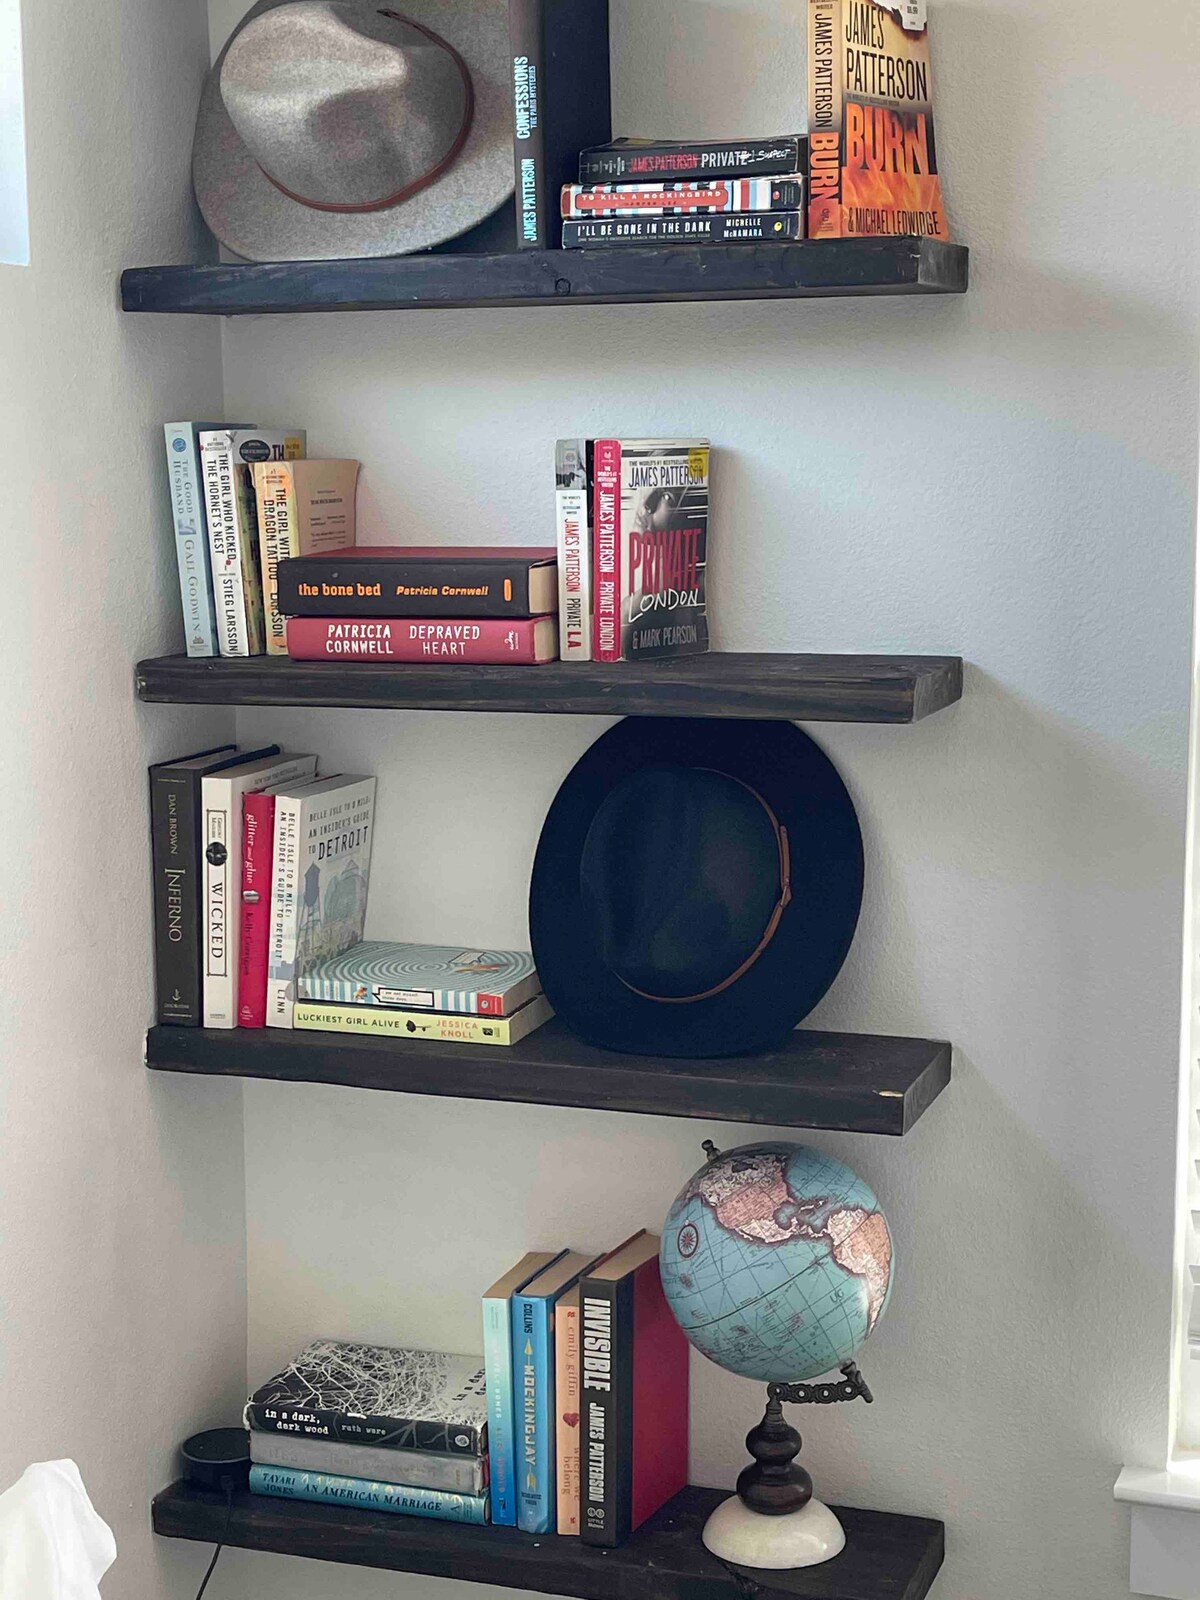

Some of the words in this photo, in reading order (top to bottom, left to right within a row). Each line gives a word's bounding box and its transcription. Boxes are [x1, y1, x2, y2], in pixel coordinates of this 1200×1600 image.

[815, 13, 832, 56] JAMES
[845, 0, 885, 50] JAMES
[846, 48, 928, 102] PATTERSON
[514, 56, 531, 140] CONFESSIONS
[815, 59, 832, 127] PATTERSON
[846, 102, 931, 173] BURN
[628, 156, 654, 173] JAMES
[655, 153, 697, 172] PATTERSON
[701, 151, 748, 168] PRIVATE
[810, 132, 839, 204] BURN
[521, 158, 536, 210] PATTERSON
[643, 191, 721, 199] MOCKINGBIRD
[524, 211, 538, 242] JAMES
[577, 225, 596, 236] I'LL
[600, 225, 612, 235] BE
[617, 224, 642, 235] GONE
[647, 223, 657, 234] IN
[662, 222, 680, 233] THE
[684, 221, 711, 233] DARK
[726, 218, 761, 227] MICHELLE
[848, 207, 854, 232] &
[855, 207, 891, 234] MICHAEL
[892, 210, 942, 235] LEDWIDGE
[207, 459, 218, 478] THE
[218, 453, 230, 472] THE
[629, 467, 658, 488] JAMES
[661, 465, 704, 486] PATTERSON
[220, 476, 231, 498] GIRL
[276, 488, 287, 507] THE
[208, 481, 222, 528] HORNET'S
[222, 499, 234, 522] WHO
[600, 491, 615, 523] JAMES
[264, 500, 277, 543] DRAGON
[277, 510, 289, 535] GIRL
[564, 518, 580, 546] JAMES
[213, 531, 225, 554] NEST
[225, 525, 237, 560] KICKED
[600, 524, 615, 574] PATTERSON
[565, 549, 581, 593] PATTERSON
[629, 531, 702, 596] PRIVATE
[223, 578, 235, 606] STIEG
[298, 583, 318, 596] the
[322, 583, 354, 596] bone
[357, 583, 381, 596] bed
[396, 585, 438, 596] Patricia
[441, 585, 489, 596] Cornwell
[600, 580, 615, 614] PRIVATE
[566, 598, 581, 629] PRIVATE
[628, 588, 703, 623] LONDON
[226, 609, 239, 652] LARSSON
[328, 624, 392, 639] PATRICIA
[409, 625, 480, 640] DEPRAVED
[600, 616, 615, 651] LONDON
[632, 634, 638, 649] &
[640, 629, 661, 649] MARK
[662, 625, 697, 647] PEARSON
[325, 640, 394, 654] CORNWELL
[422, 641, 466, 656] HEART
[168, 794, 176, 815] DAN
[280, 811, 287, 821] AN
[309, 809, 328, 823] BELLE
[330, 806, 342, 819] ISLE
[168, 817, 178, 855] BROWN
[246, 813, 258, 847] glitter
[287, 813, 295, 838] BELLE
[308, 827, 317, 839] AN
[320, 818, 351, 836] INSIDER'S
[353, 811, 370, 824] GUIDE
[278, 827, 287, 873] INSIDER'S
[287, 845, 295, 863] ISLE
[308, 845, 316, 854] TO
[318, 826, 369, 861] DETROIT
[245, 860, 257, 884] glue
[286, 869, 294, 879] TO
[277, 878, 285, 903] GUIDE
[164, 868, 186, 943] INFERNO
[276, 908, 283, 918] TO
[211, 882, 223, 959] WICKED
[275, 923, 283, 959] DETROIT
[277, 989, 285, 1014] LINN
[297, 1013, 343, 1024] LUCKIEST
[346, 1017, 368, 1026] GIRL
[371, 1019, 400, 1029] ALIVE
[436, 1020, 478, 1030] JESSICA
[441, 1029, 474, 1039] KNOLL
[524, 1304, 532, 1334] COLLINS
[566, 1326, 577, 1358] emily
[584, 1297, 610, 1392] INVISIBLE
[566, 1364, 577, 1396] giffin
[265, 1408, 277, 1418] in
[292, 1411, 321, 1424] dark,
[276, 1421, 300, 1432] dark
[305, 1424, 329, 1435] wood
[524, 1365, 535, 1466] MOCKINGJAY
[589, 1402, 605, 1440] JAMES
[341, 1424, 362, 1434] ruth
[366, 1426, 386, 1436] ware
[262, 1473, 296, 1485] TAYARI
[561, 1456, 573, 1495] belong
[589, 1442, 605, 1503] PATTERSON
[263, 1483, 294, 1496] JONES
[304, 1483, 318, 1494] AN
[321, 1487, 380, 1503] AMERICAN
[384, 1495, 442, 1512] MARRIAGE
